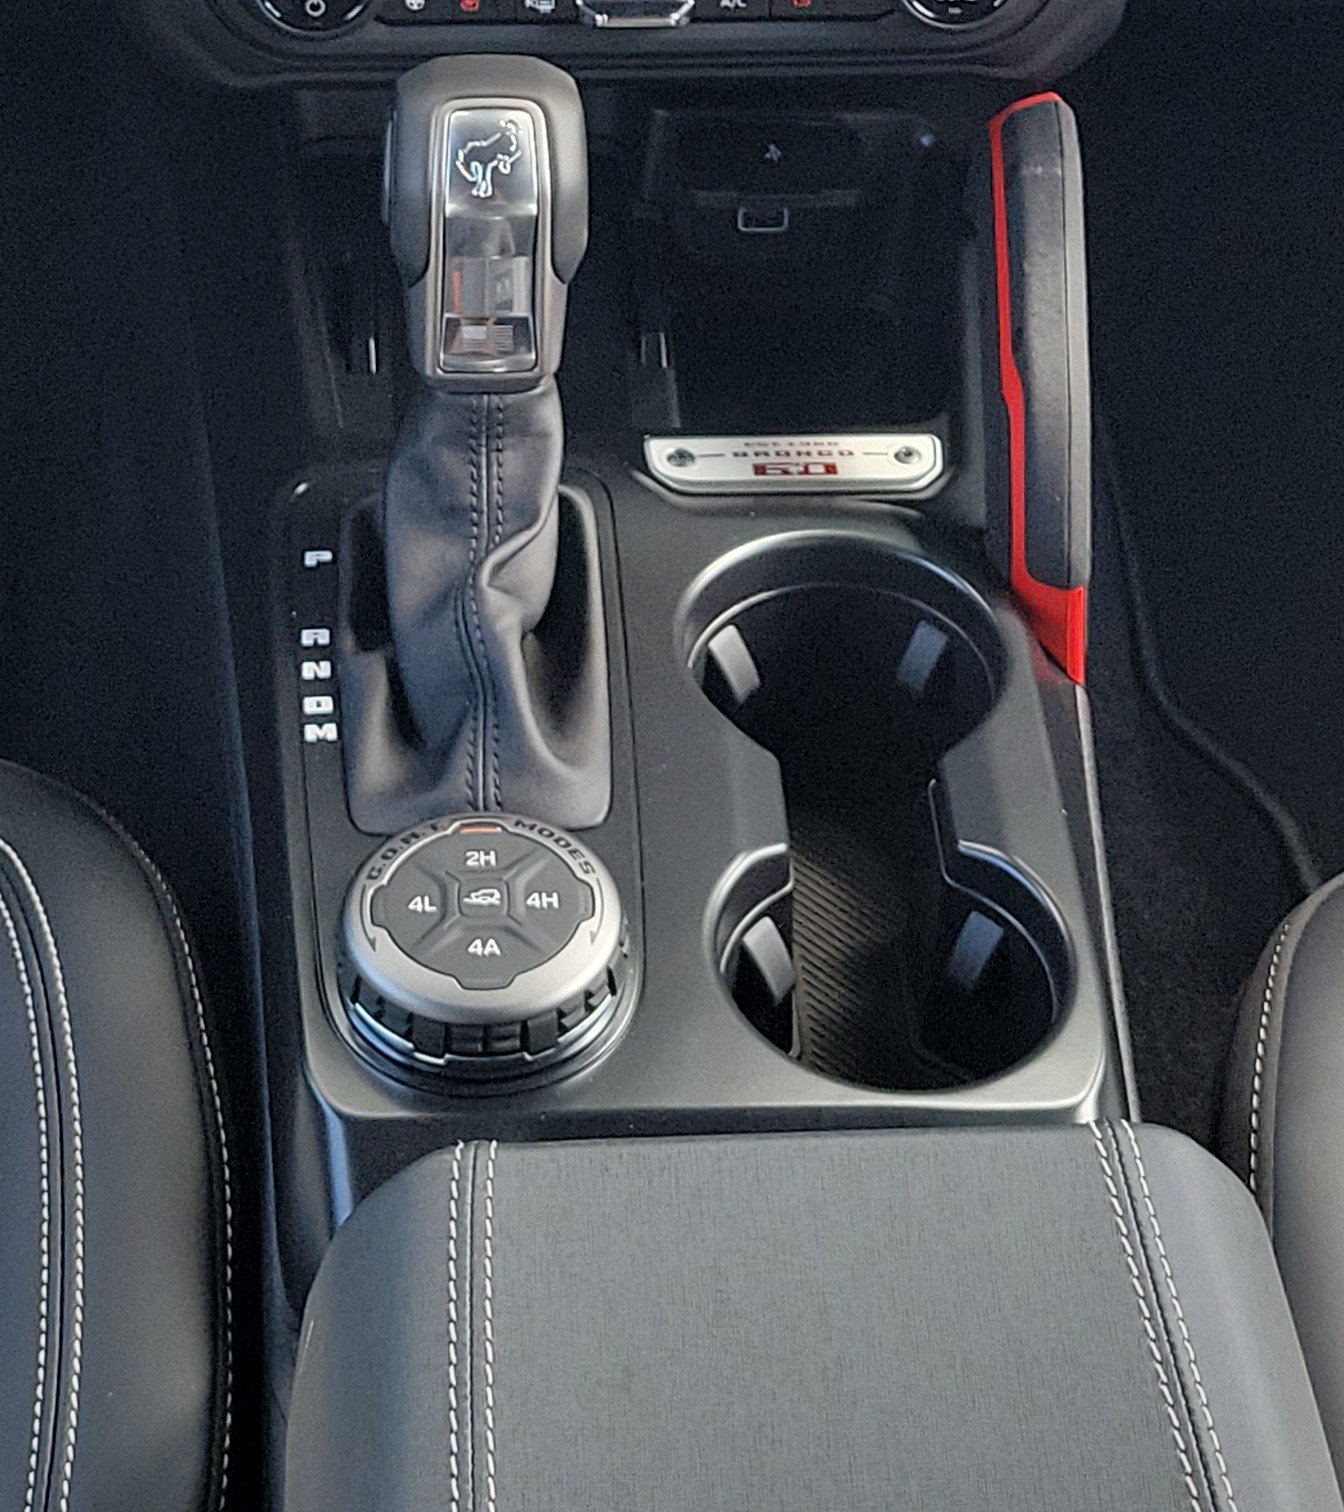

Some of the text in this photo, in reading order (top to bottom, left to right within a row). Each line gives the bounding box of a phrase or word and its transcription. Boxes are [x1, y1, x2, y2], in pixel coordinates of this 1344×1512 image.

[304, 549, 334, 568] P
[301, 660, 332, 680] N
[302, 695, 334, 715] D
[303, 722, 338, 743] M
[513, 818, 597, 876] MODES
[465, 849, 497, 868] 2H
[408, 895, 438, 913] 4L
[526, 891, 560, 910] 4H
[467, 938, 502, 957] 4A
